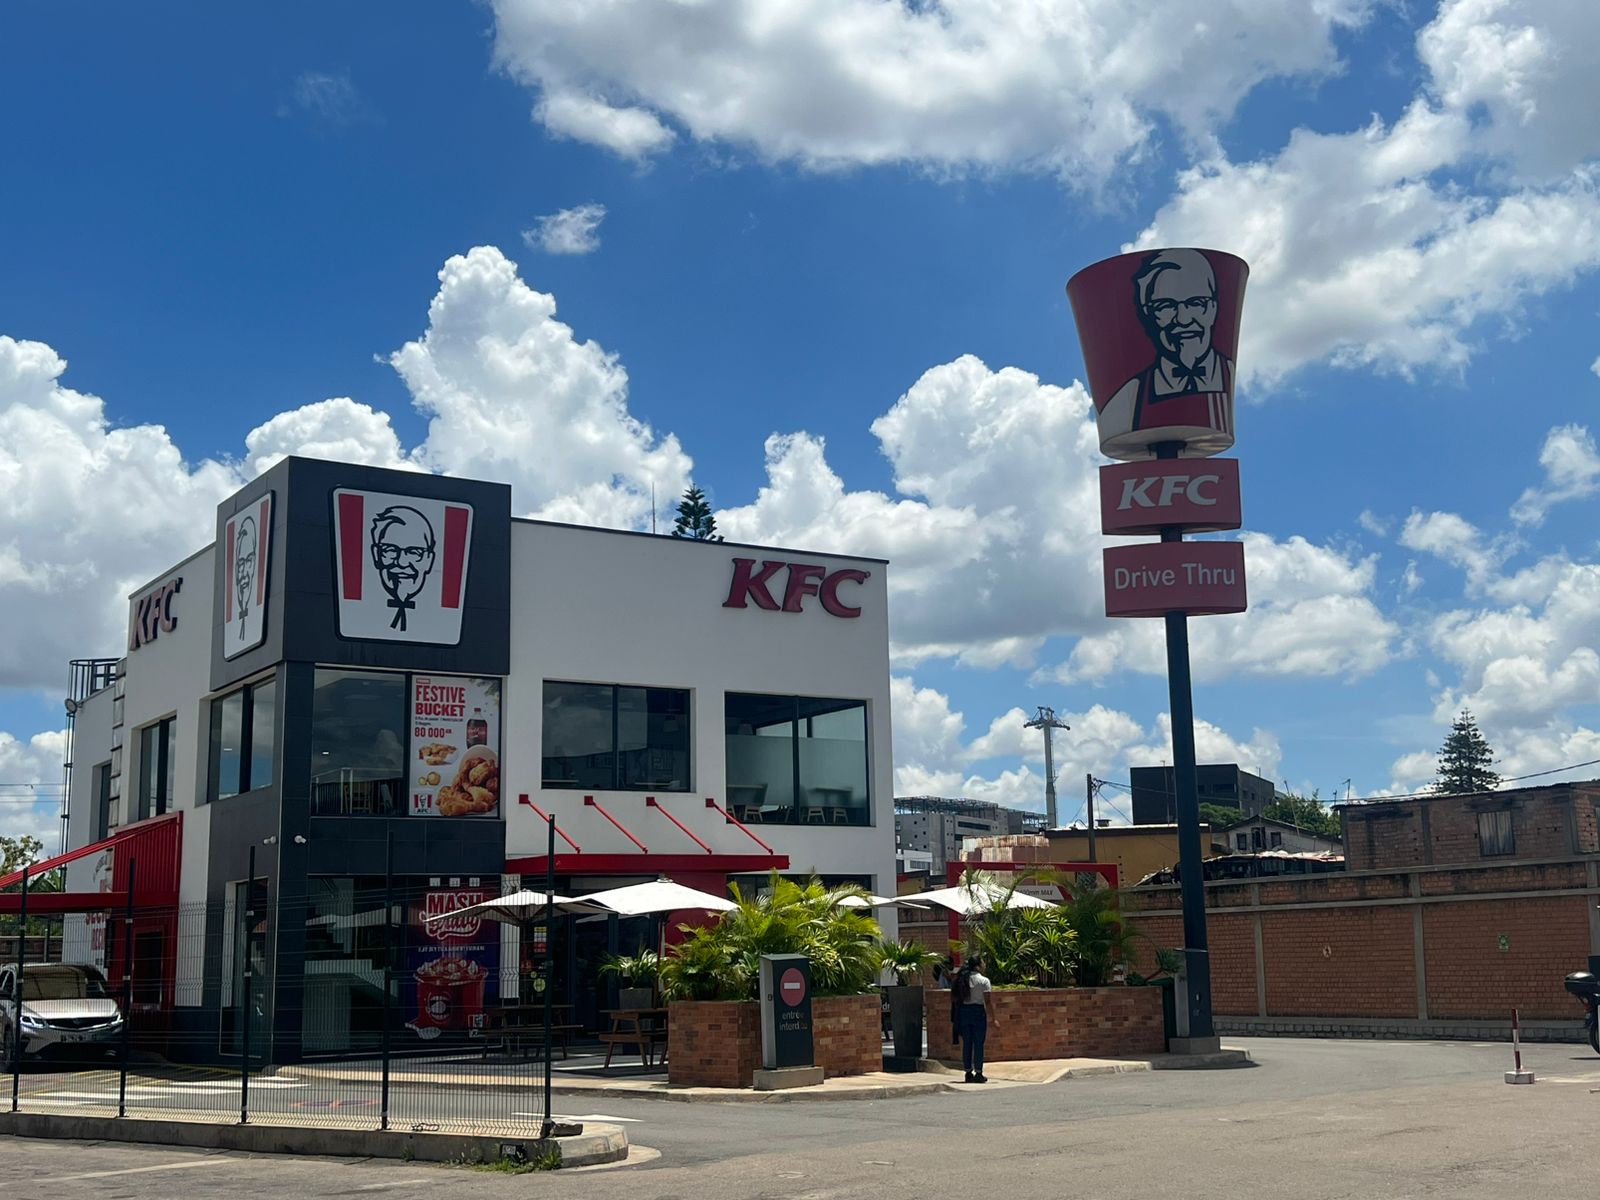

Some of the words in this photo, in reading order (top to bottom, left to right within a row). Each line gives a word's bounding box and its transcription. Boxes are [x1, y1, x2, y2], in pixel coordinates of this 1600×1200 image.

[1117, 475, 1219, 510] KFC
[722, 557, 866, 618] KFC
[1115, 566, 1176, 590] Drive
[1182, 562, 1236, 586] Thru
[130, 577, 183, 650] KFC
[415, 685, 466, 704] FESTIVE
[415, 703, 466, 717] BUCKET
[414, 727, 426, 737] 80
[428, 727, 445, 738] 000
[428, 894, 482, 914] MASH
